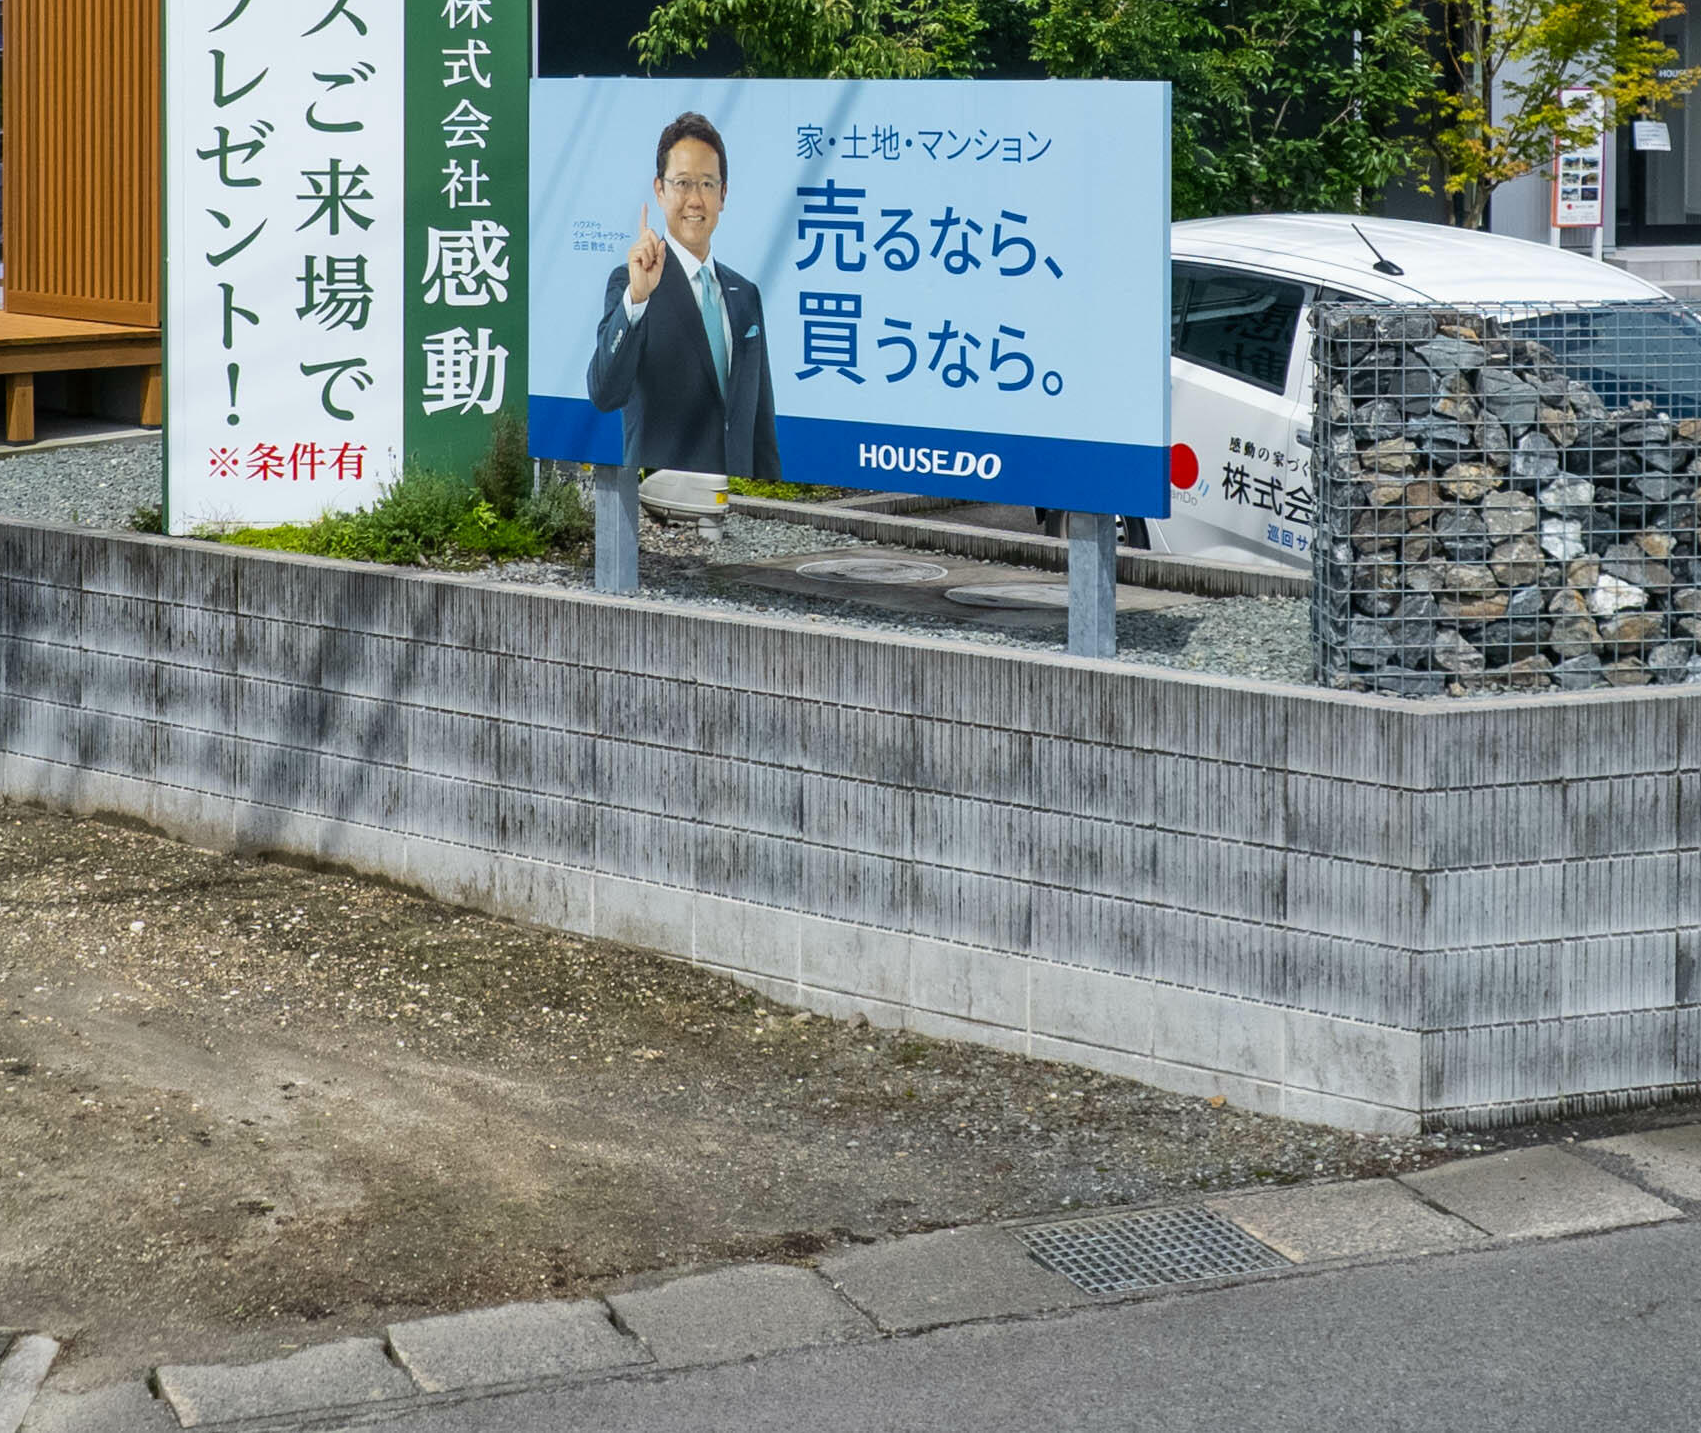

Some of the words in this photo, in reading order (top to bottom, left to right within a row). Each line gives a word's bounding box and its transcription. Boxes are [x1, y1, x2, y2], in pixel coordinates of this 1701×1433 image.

[796, 123, 1052, 164] 家・土地・マンション
[795, 178, 1064, 280] 売るなら、
[794, 291, 1064, 396] 買うなら。
[1171, 491, 1198, 507] anDo
[1222, 461, 1316, 526] 株式会
